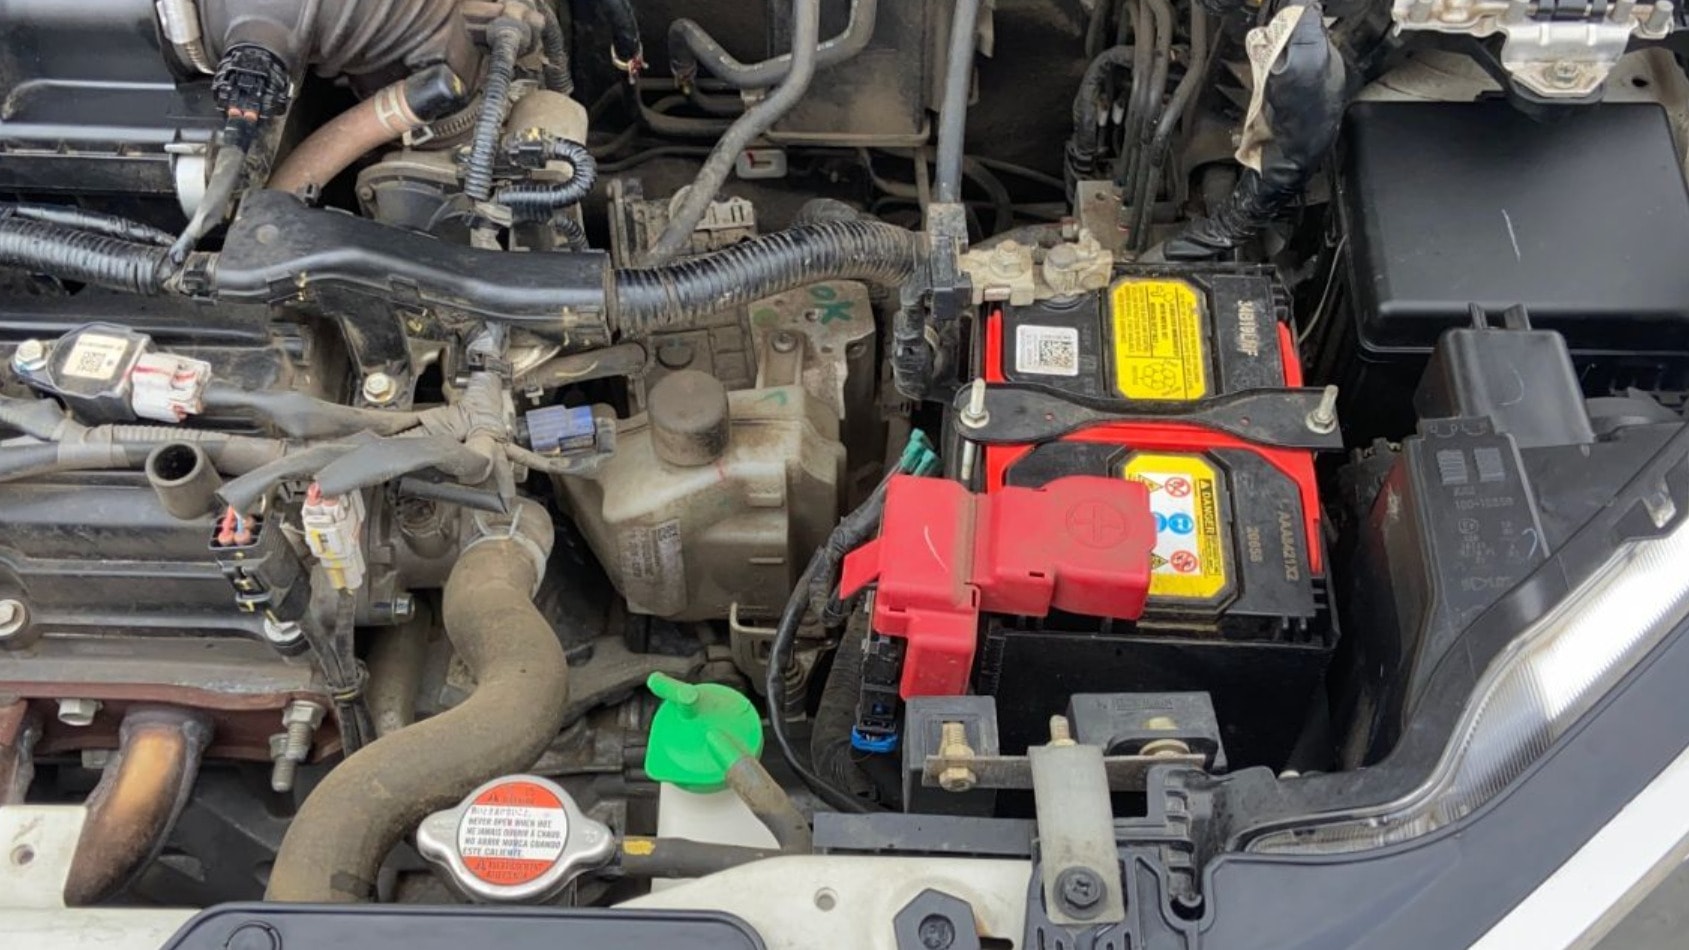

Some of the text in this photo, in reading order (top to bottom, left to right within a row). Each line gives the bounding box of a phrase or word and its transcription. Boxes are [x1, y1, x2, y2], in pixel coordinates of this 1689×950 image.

[810, 285, 855, 325] OK
[1202, 491, 1216, 534] DANGER
[468, 818, 493, 827] NEVER
[493, 819, 513, 827] OPEN
[514, 819, 536, 828] WHEN
[465, 837, 476, 845] NO
[462, 846, 481, 855] ESTE
